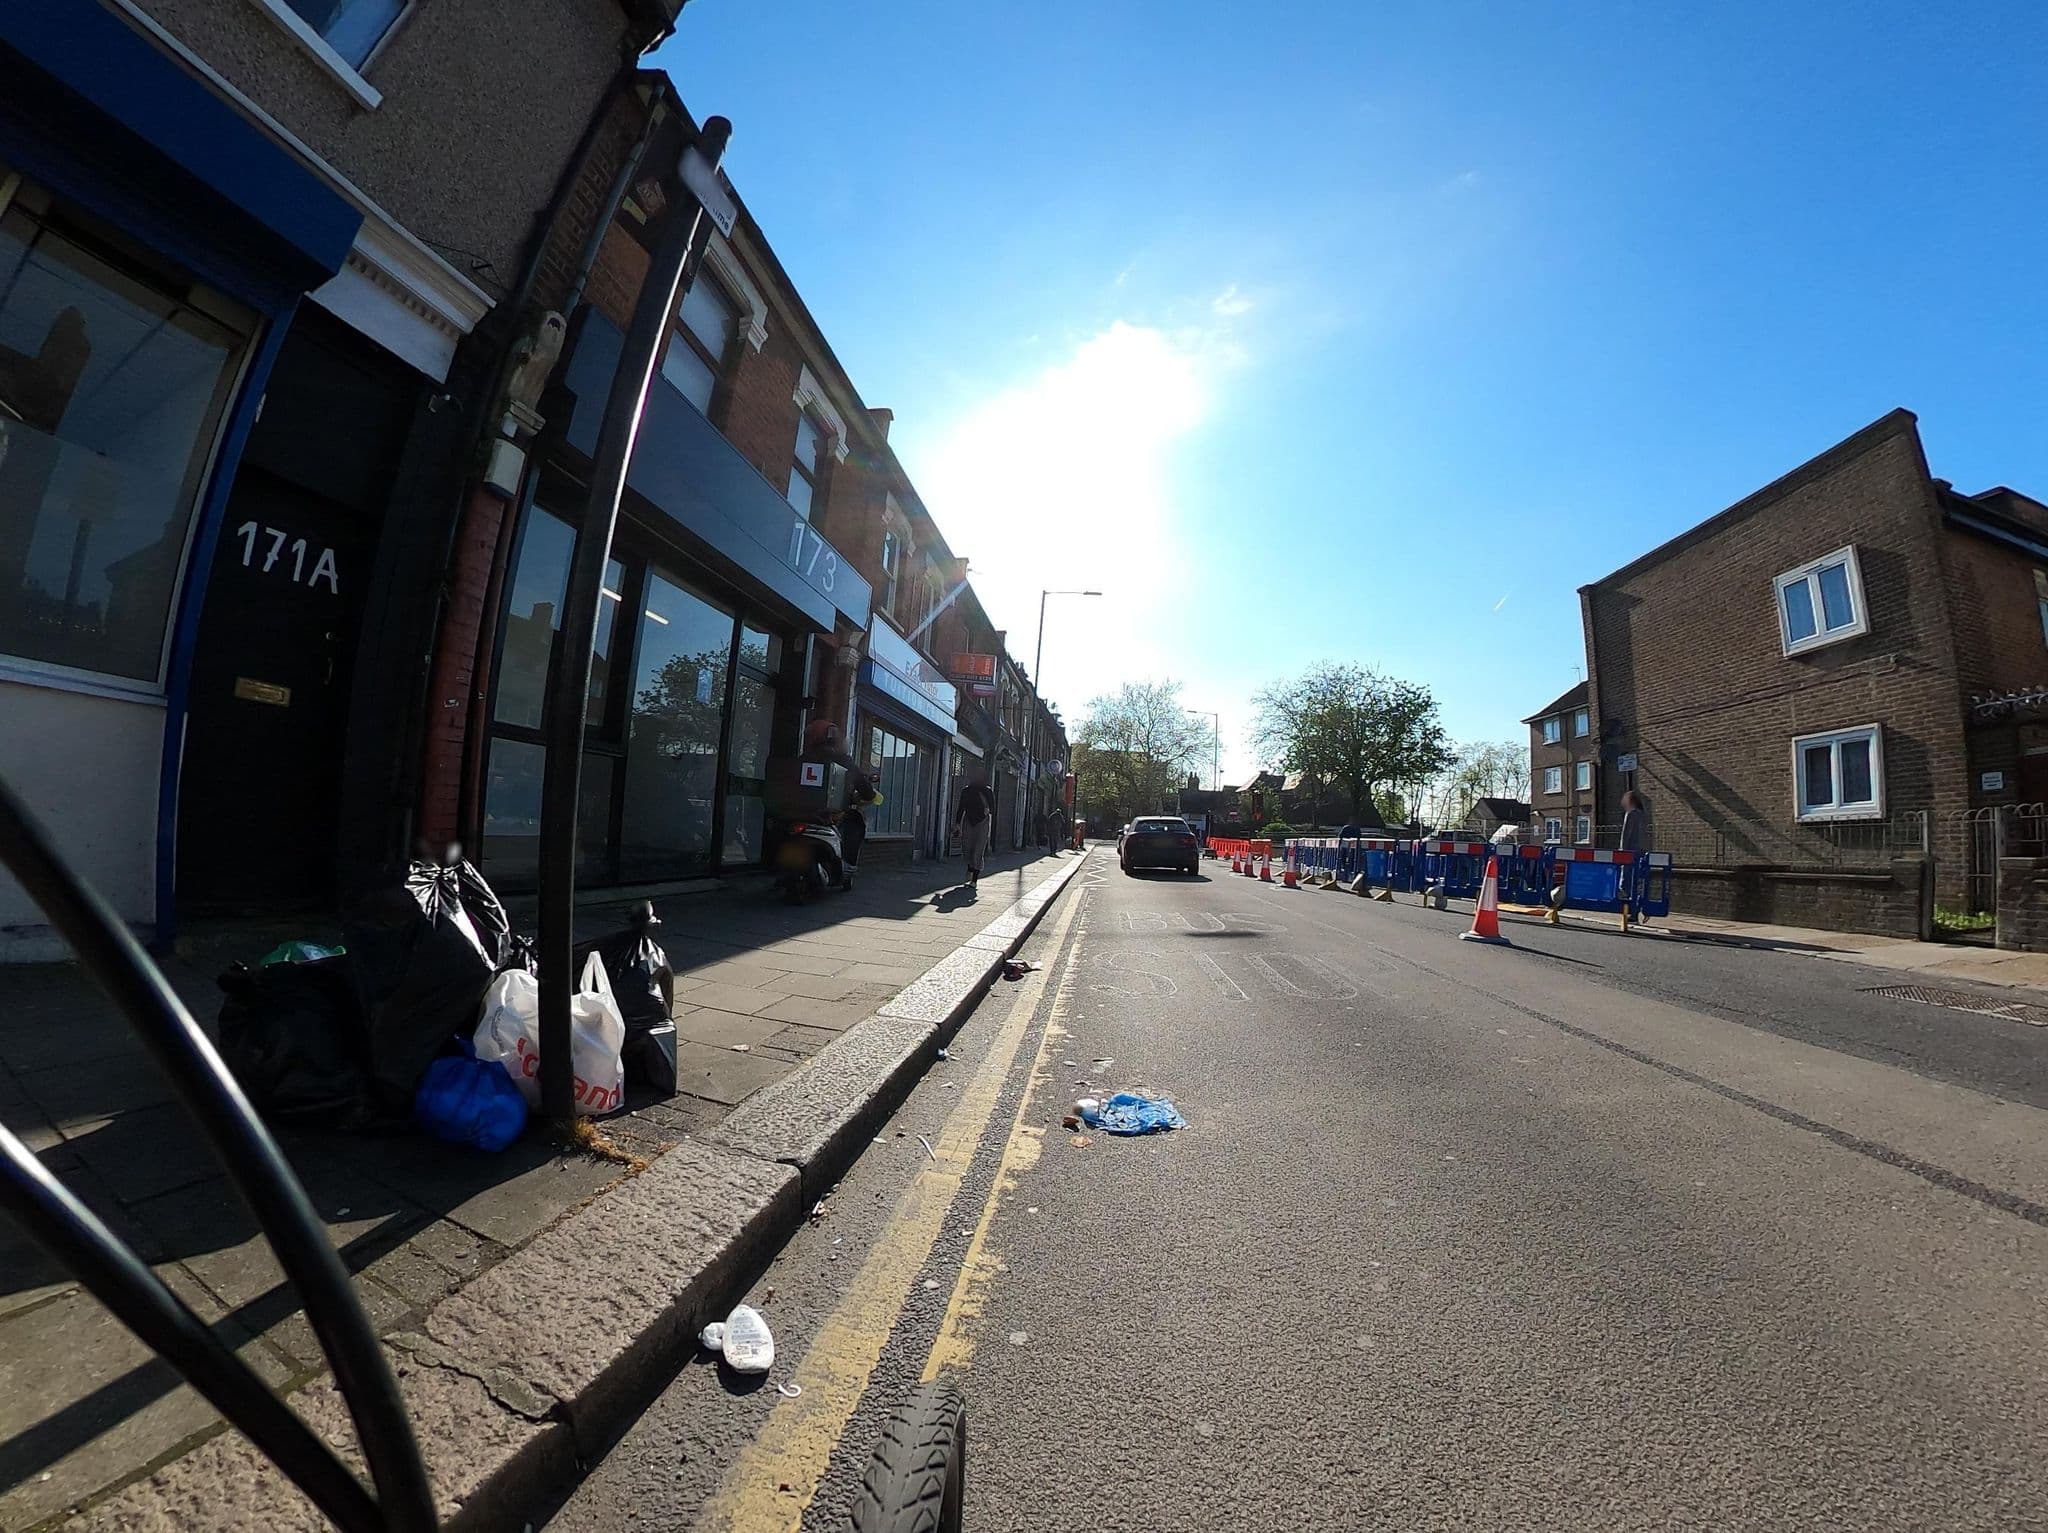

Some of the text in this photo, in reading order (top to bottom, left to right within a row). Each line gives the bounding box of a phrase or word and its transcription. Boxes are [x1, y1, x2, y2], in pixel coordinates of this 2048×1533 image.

[237, 521, 339, 595] 171A
[794, 522, 837, 593] 173
[806, 767, 818, 781] L
[1116, 911, 1288, 933] BUS
